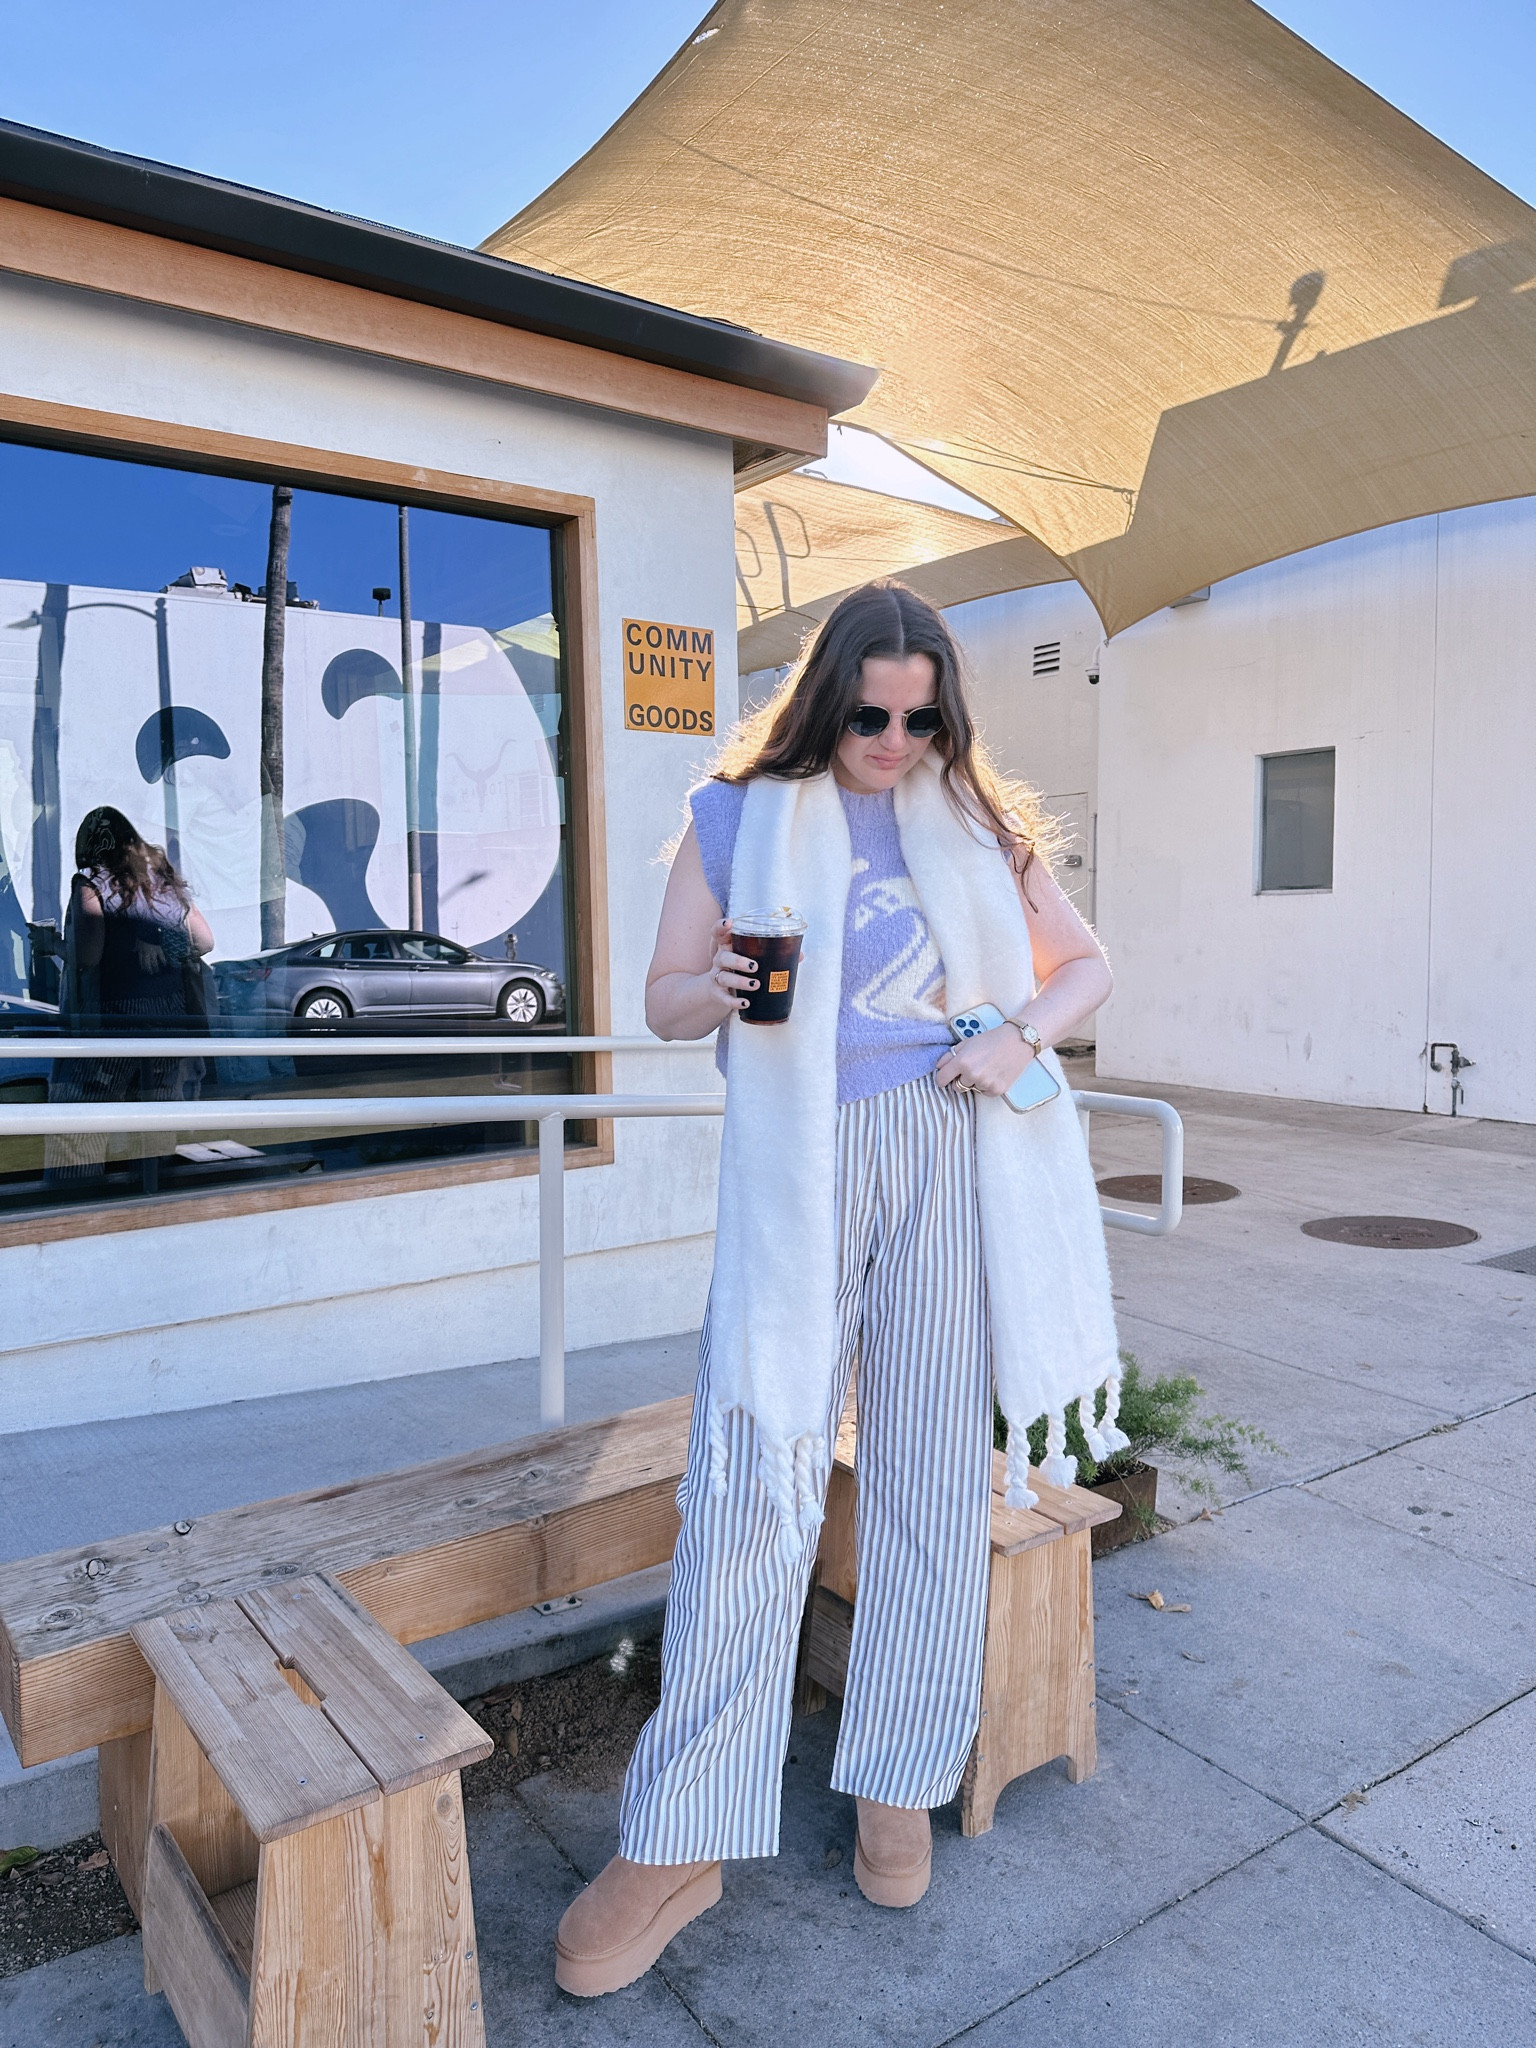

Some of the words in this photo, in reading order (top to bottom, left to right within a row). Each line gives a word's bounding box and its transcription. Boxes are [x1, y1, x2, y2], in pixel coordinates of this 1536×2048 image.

[626, 623, 712, 655] COMM
[628, 651, 712, 682] UNITY
[628, 703, 713, 732] GOODS
